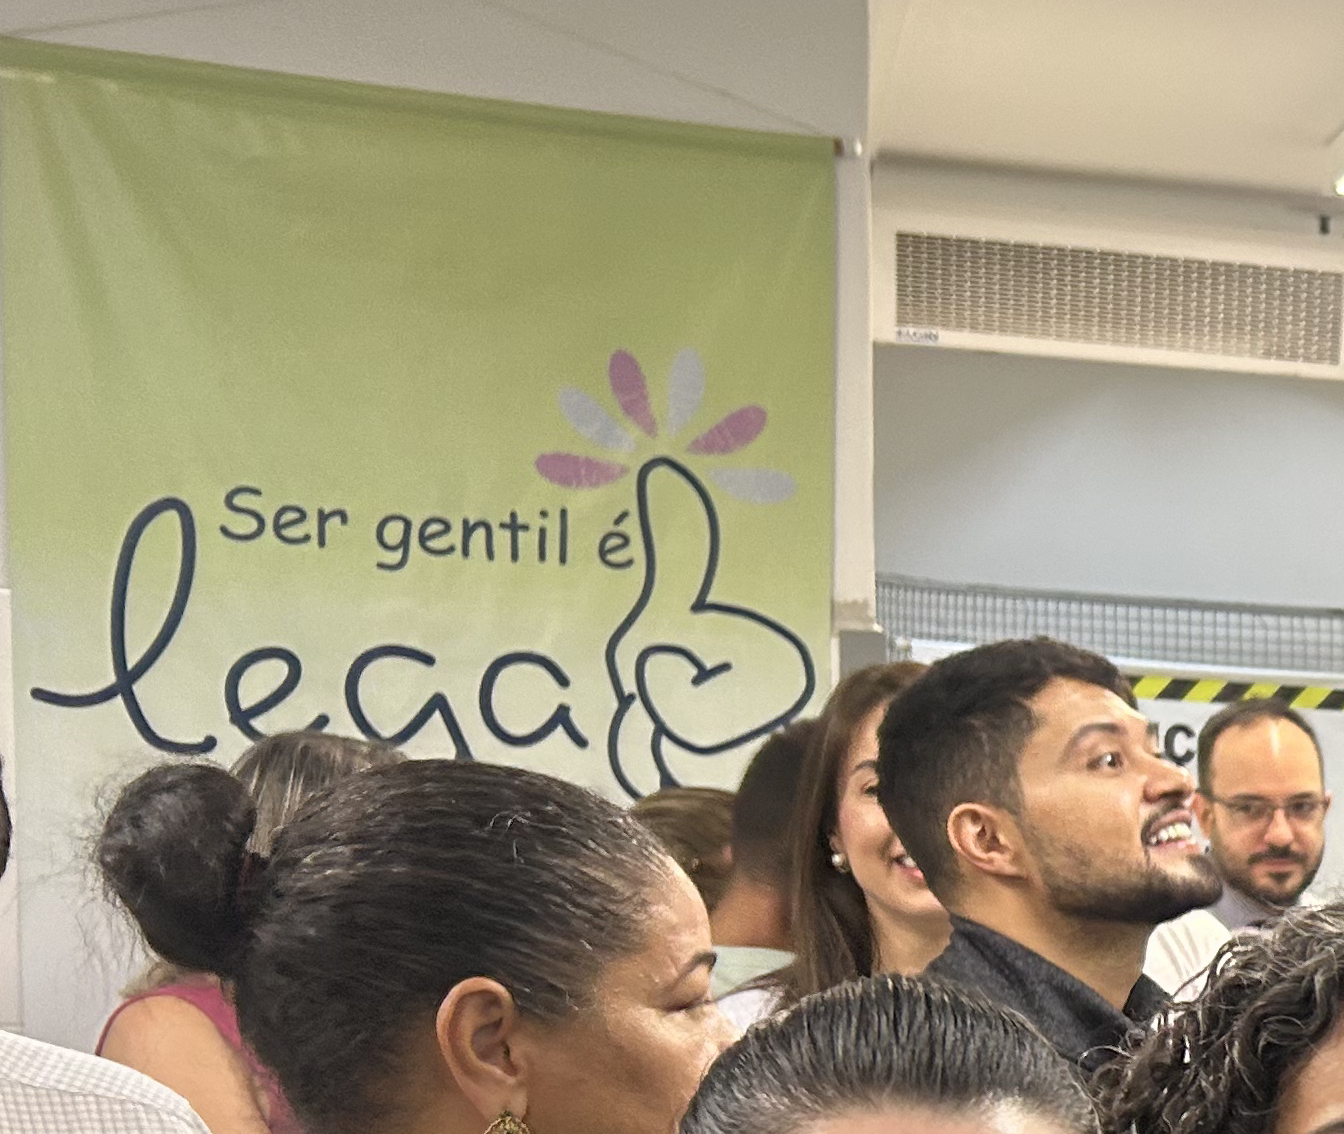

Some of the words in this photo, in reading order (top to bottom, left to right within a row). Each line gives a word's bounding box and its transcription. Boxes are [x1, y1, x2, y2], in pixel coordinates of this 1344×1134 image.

[219, 486, 348, 549] Ser
[374, 507, 570, 571] gentil
[598, 510, 635, 570] é
